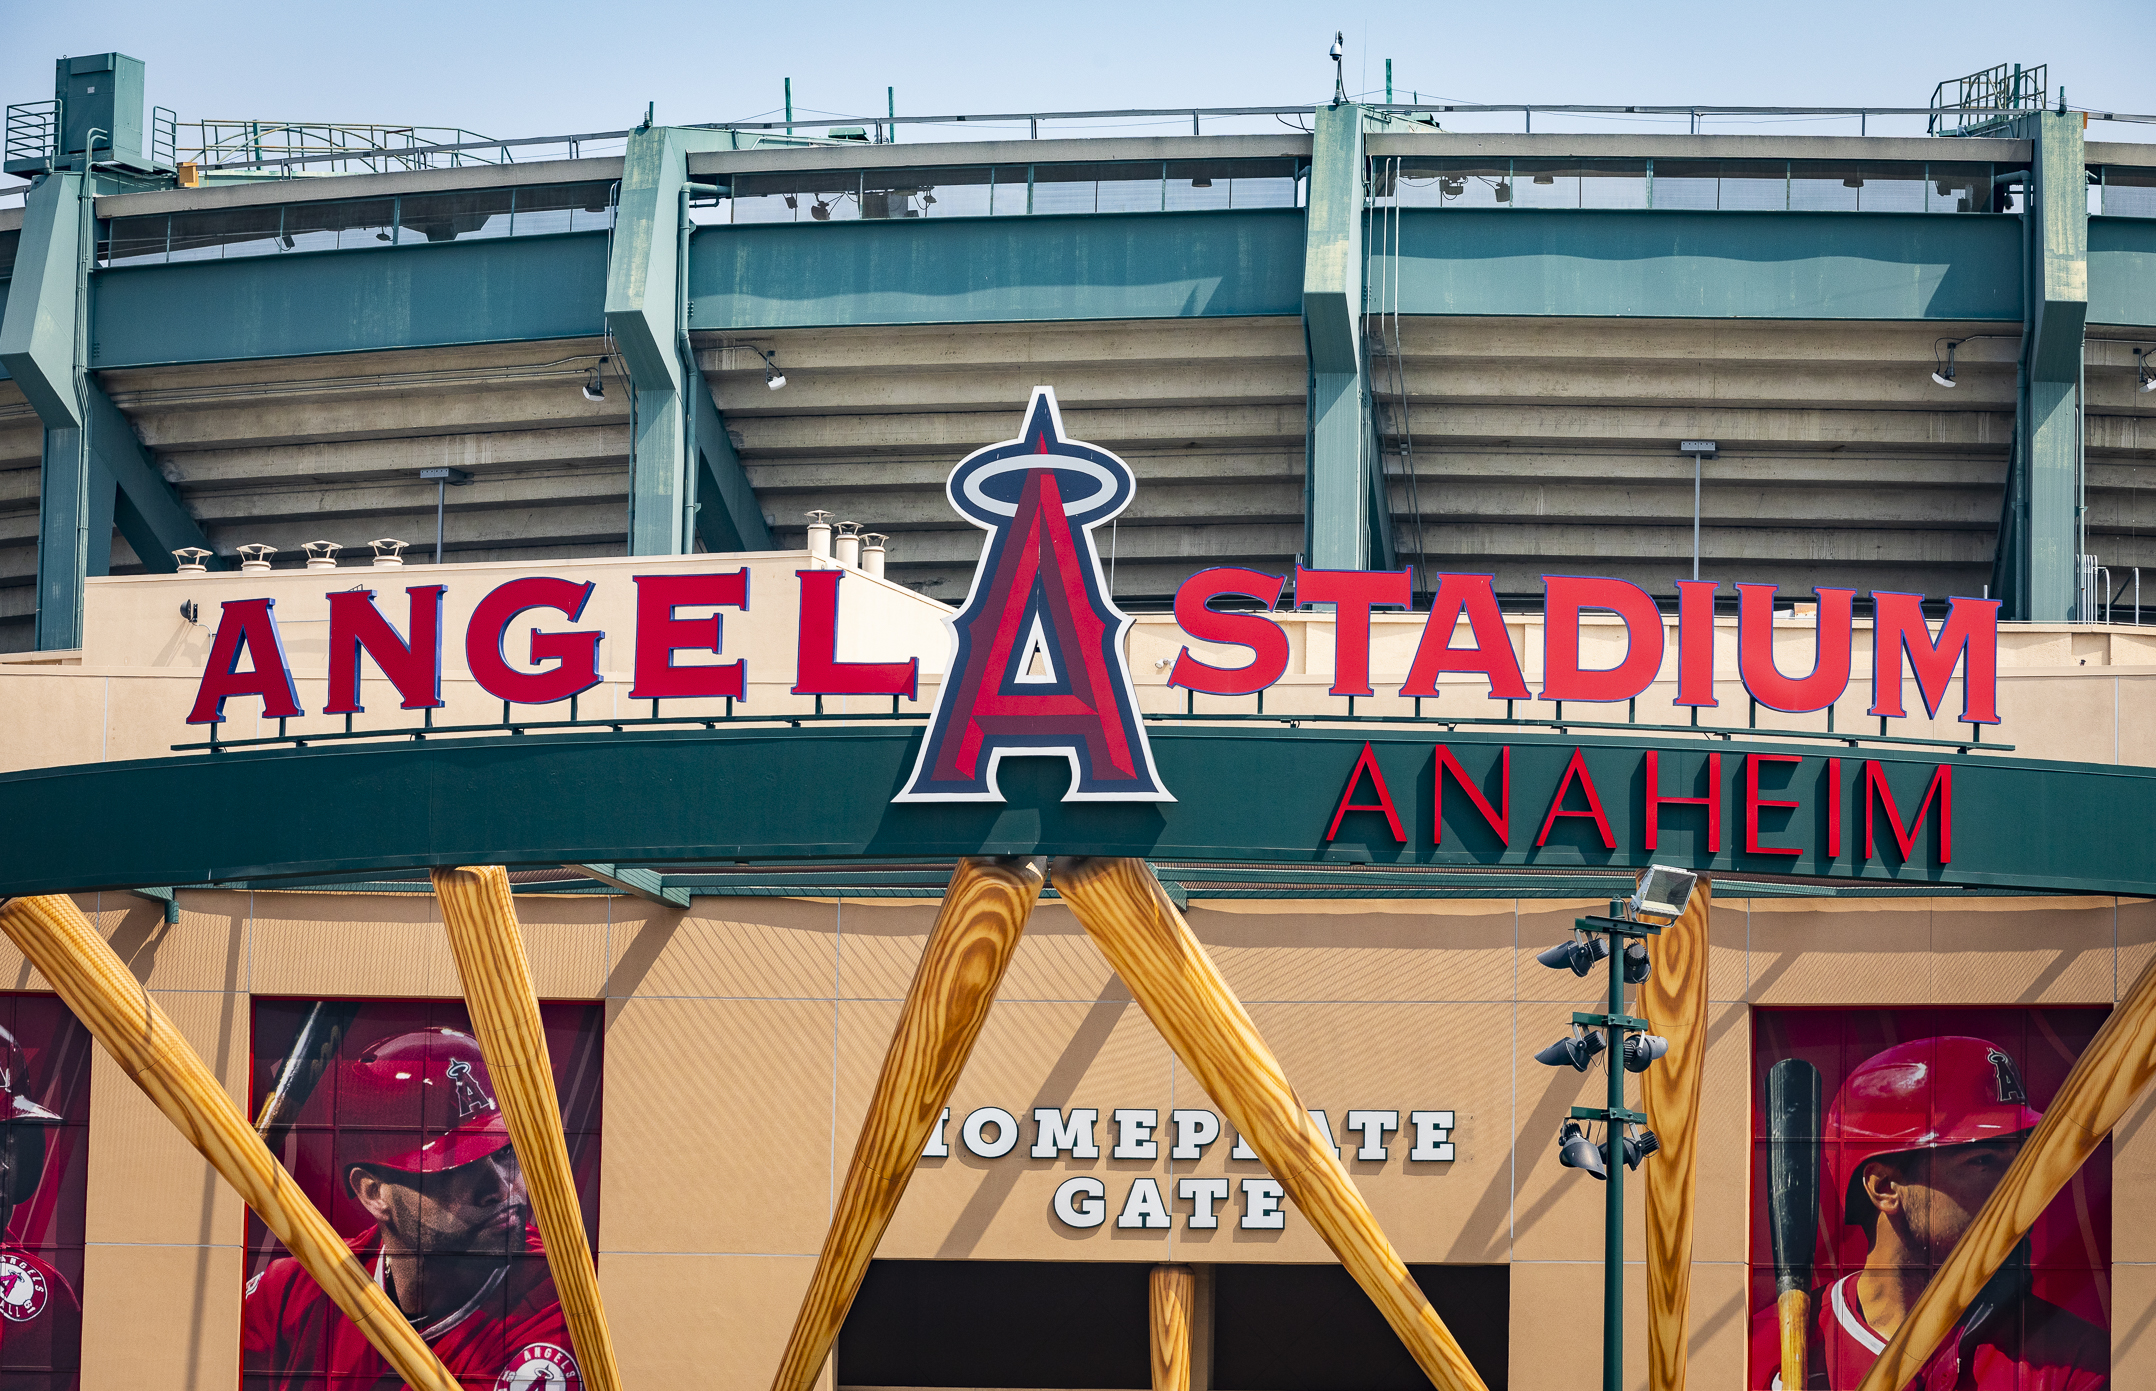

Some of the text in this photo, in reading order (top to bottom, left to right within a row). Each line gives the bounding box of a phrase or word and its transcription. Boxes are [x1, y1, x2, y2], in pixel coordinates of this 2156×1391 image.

[186, 563, 2003, 726] ANGEL STADIUM
[1325, 740, 1952, 865] ANAHEIM
[1053, 1176, 1286, 1230] GATE
[523, 1346, 576, 1378] ANGELS
